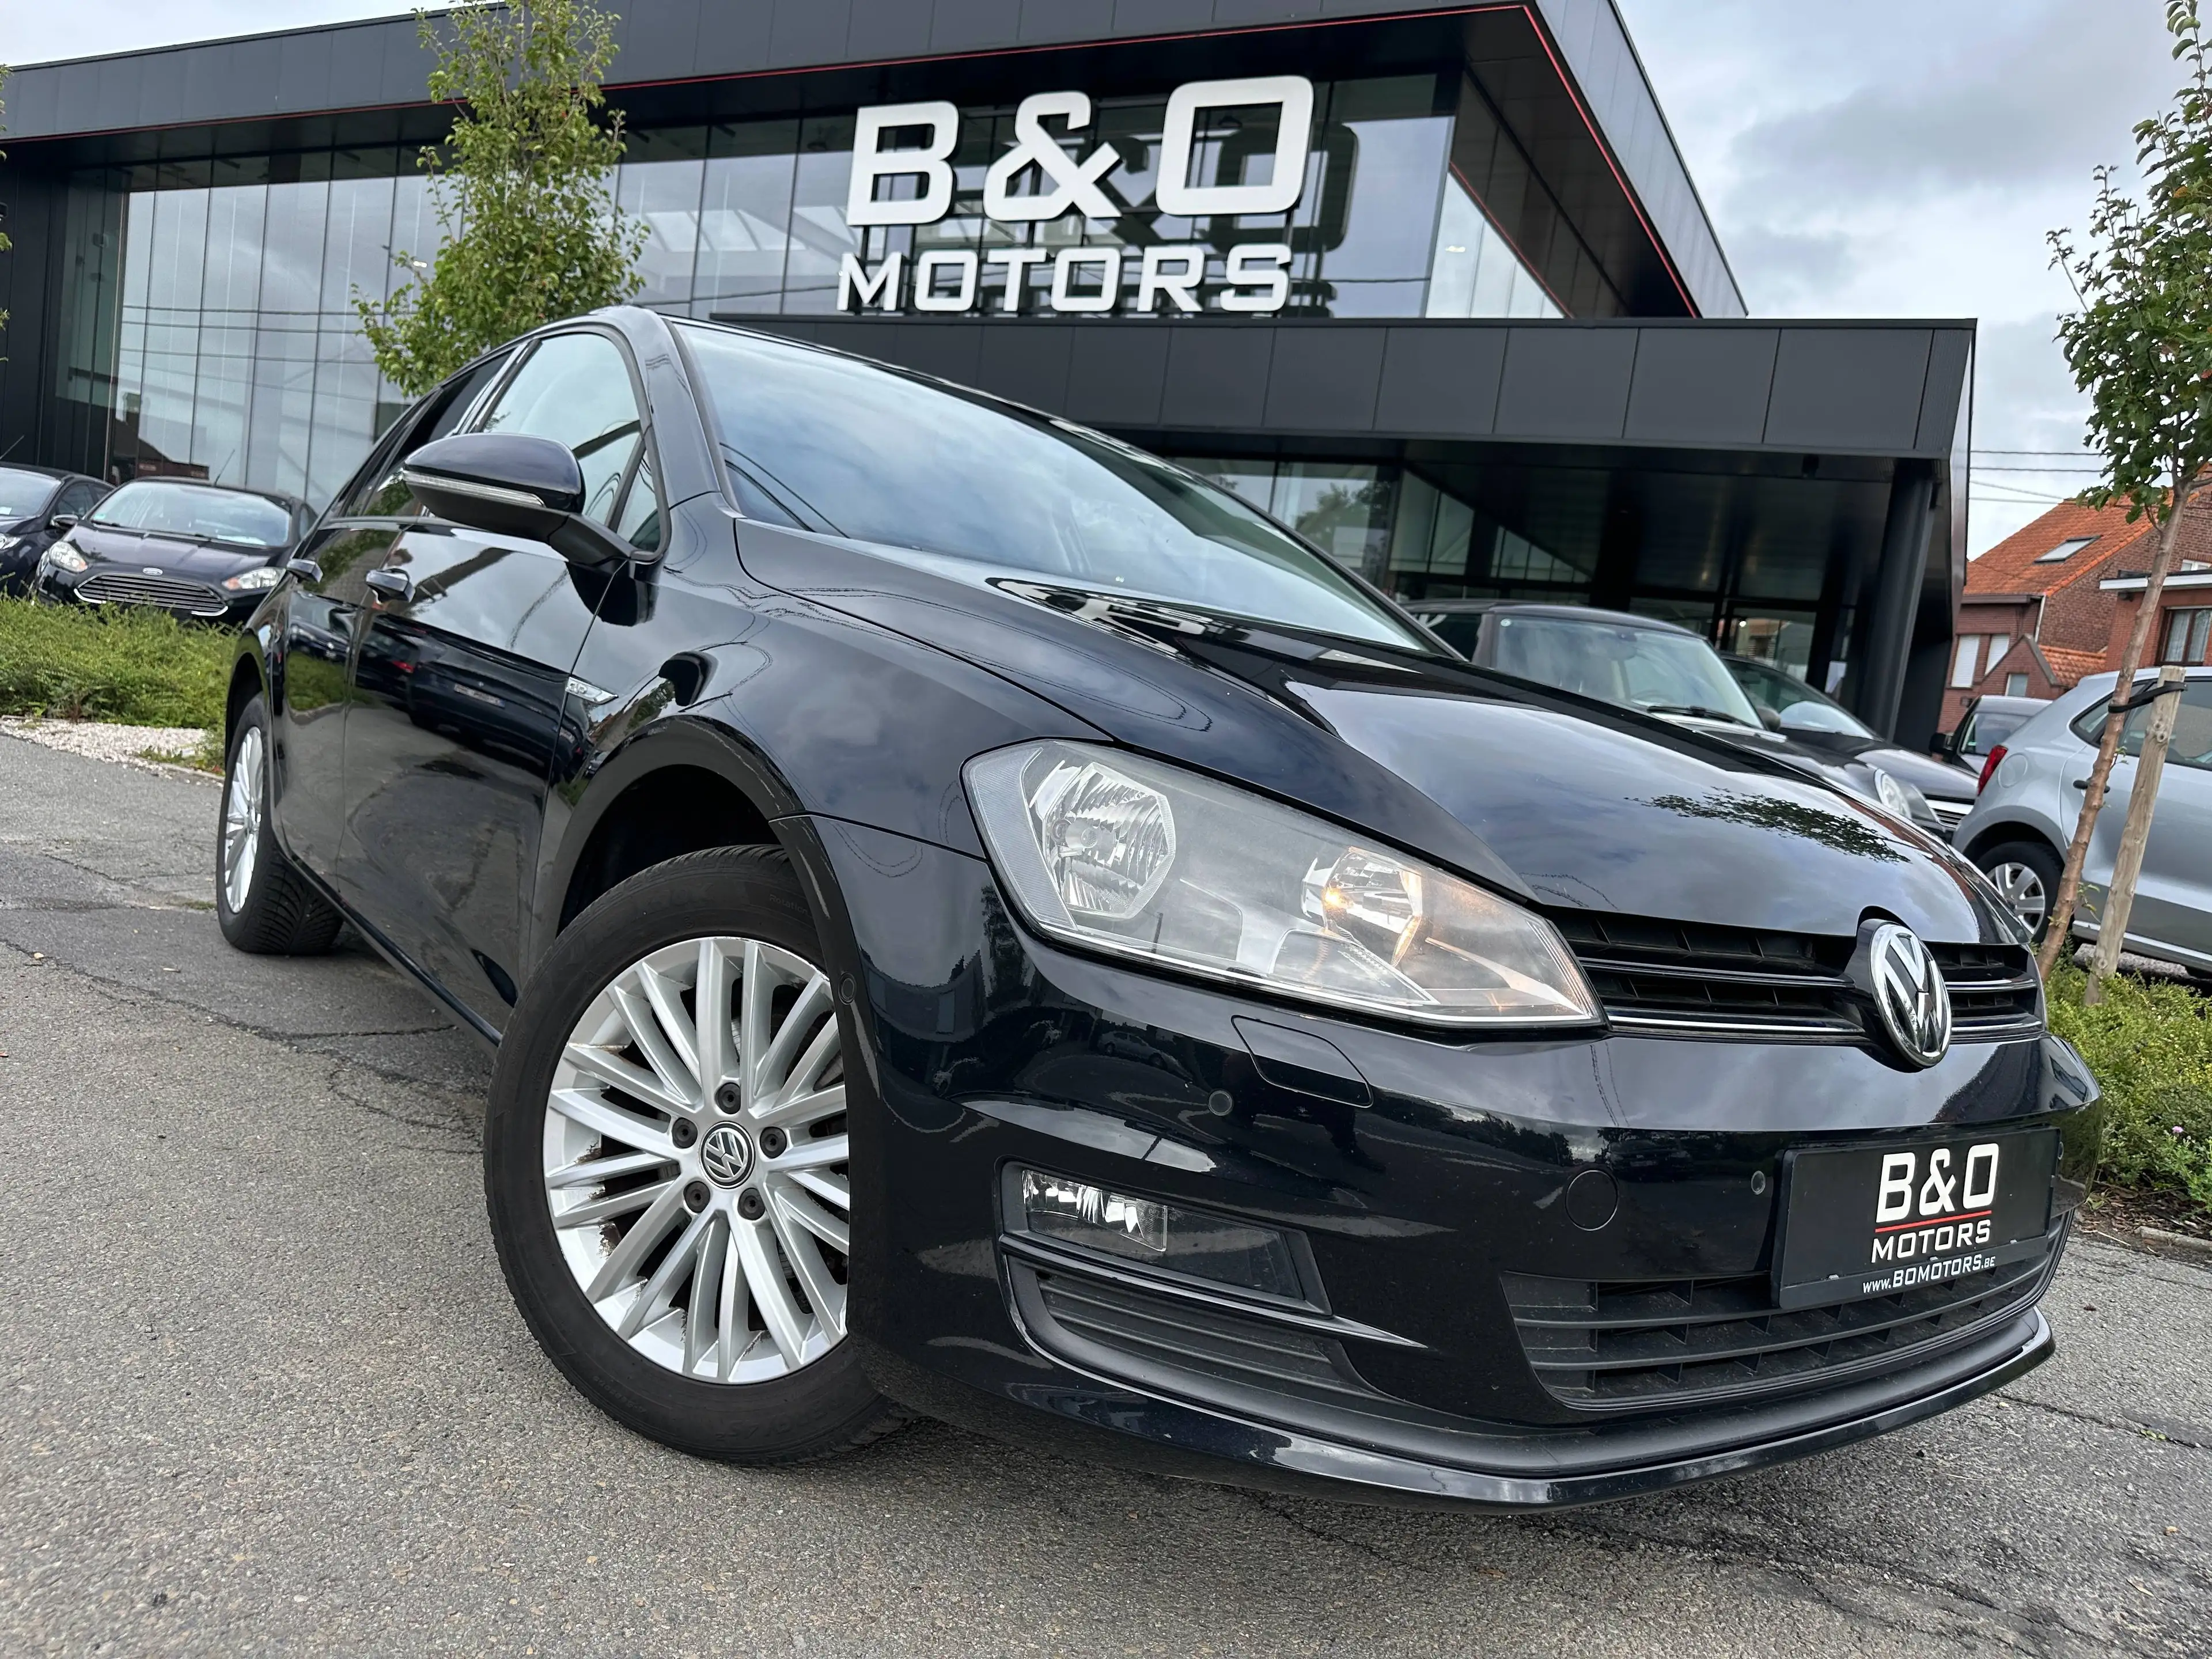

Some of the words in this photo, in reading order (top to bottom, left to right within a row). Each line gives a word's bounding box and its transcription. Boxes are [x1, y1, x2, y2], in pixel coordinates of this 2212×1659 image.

[846, 75, 1314, 226] B&O
[836, 244, 1292, 312] MOTORS
[1875, 1142, 1999, 1224] B&O
[1870, 1218, 1991, 1263] MOTORS
